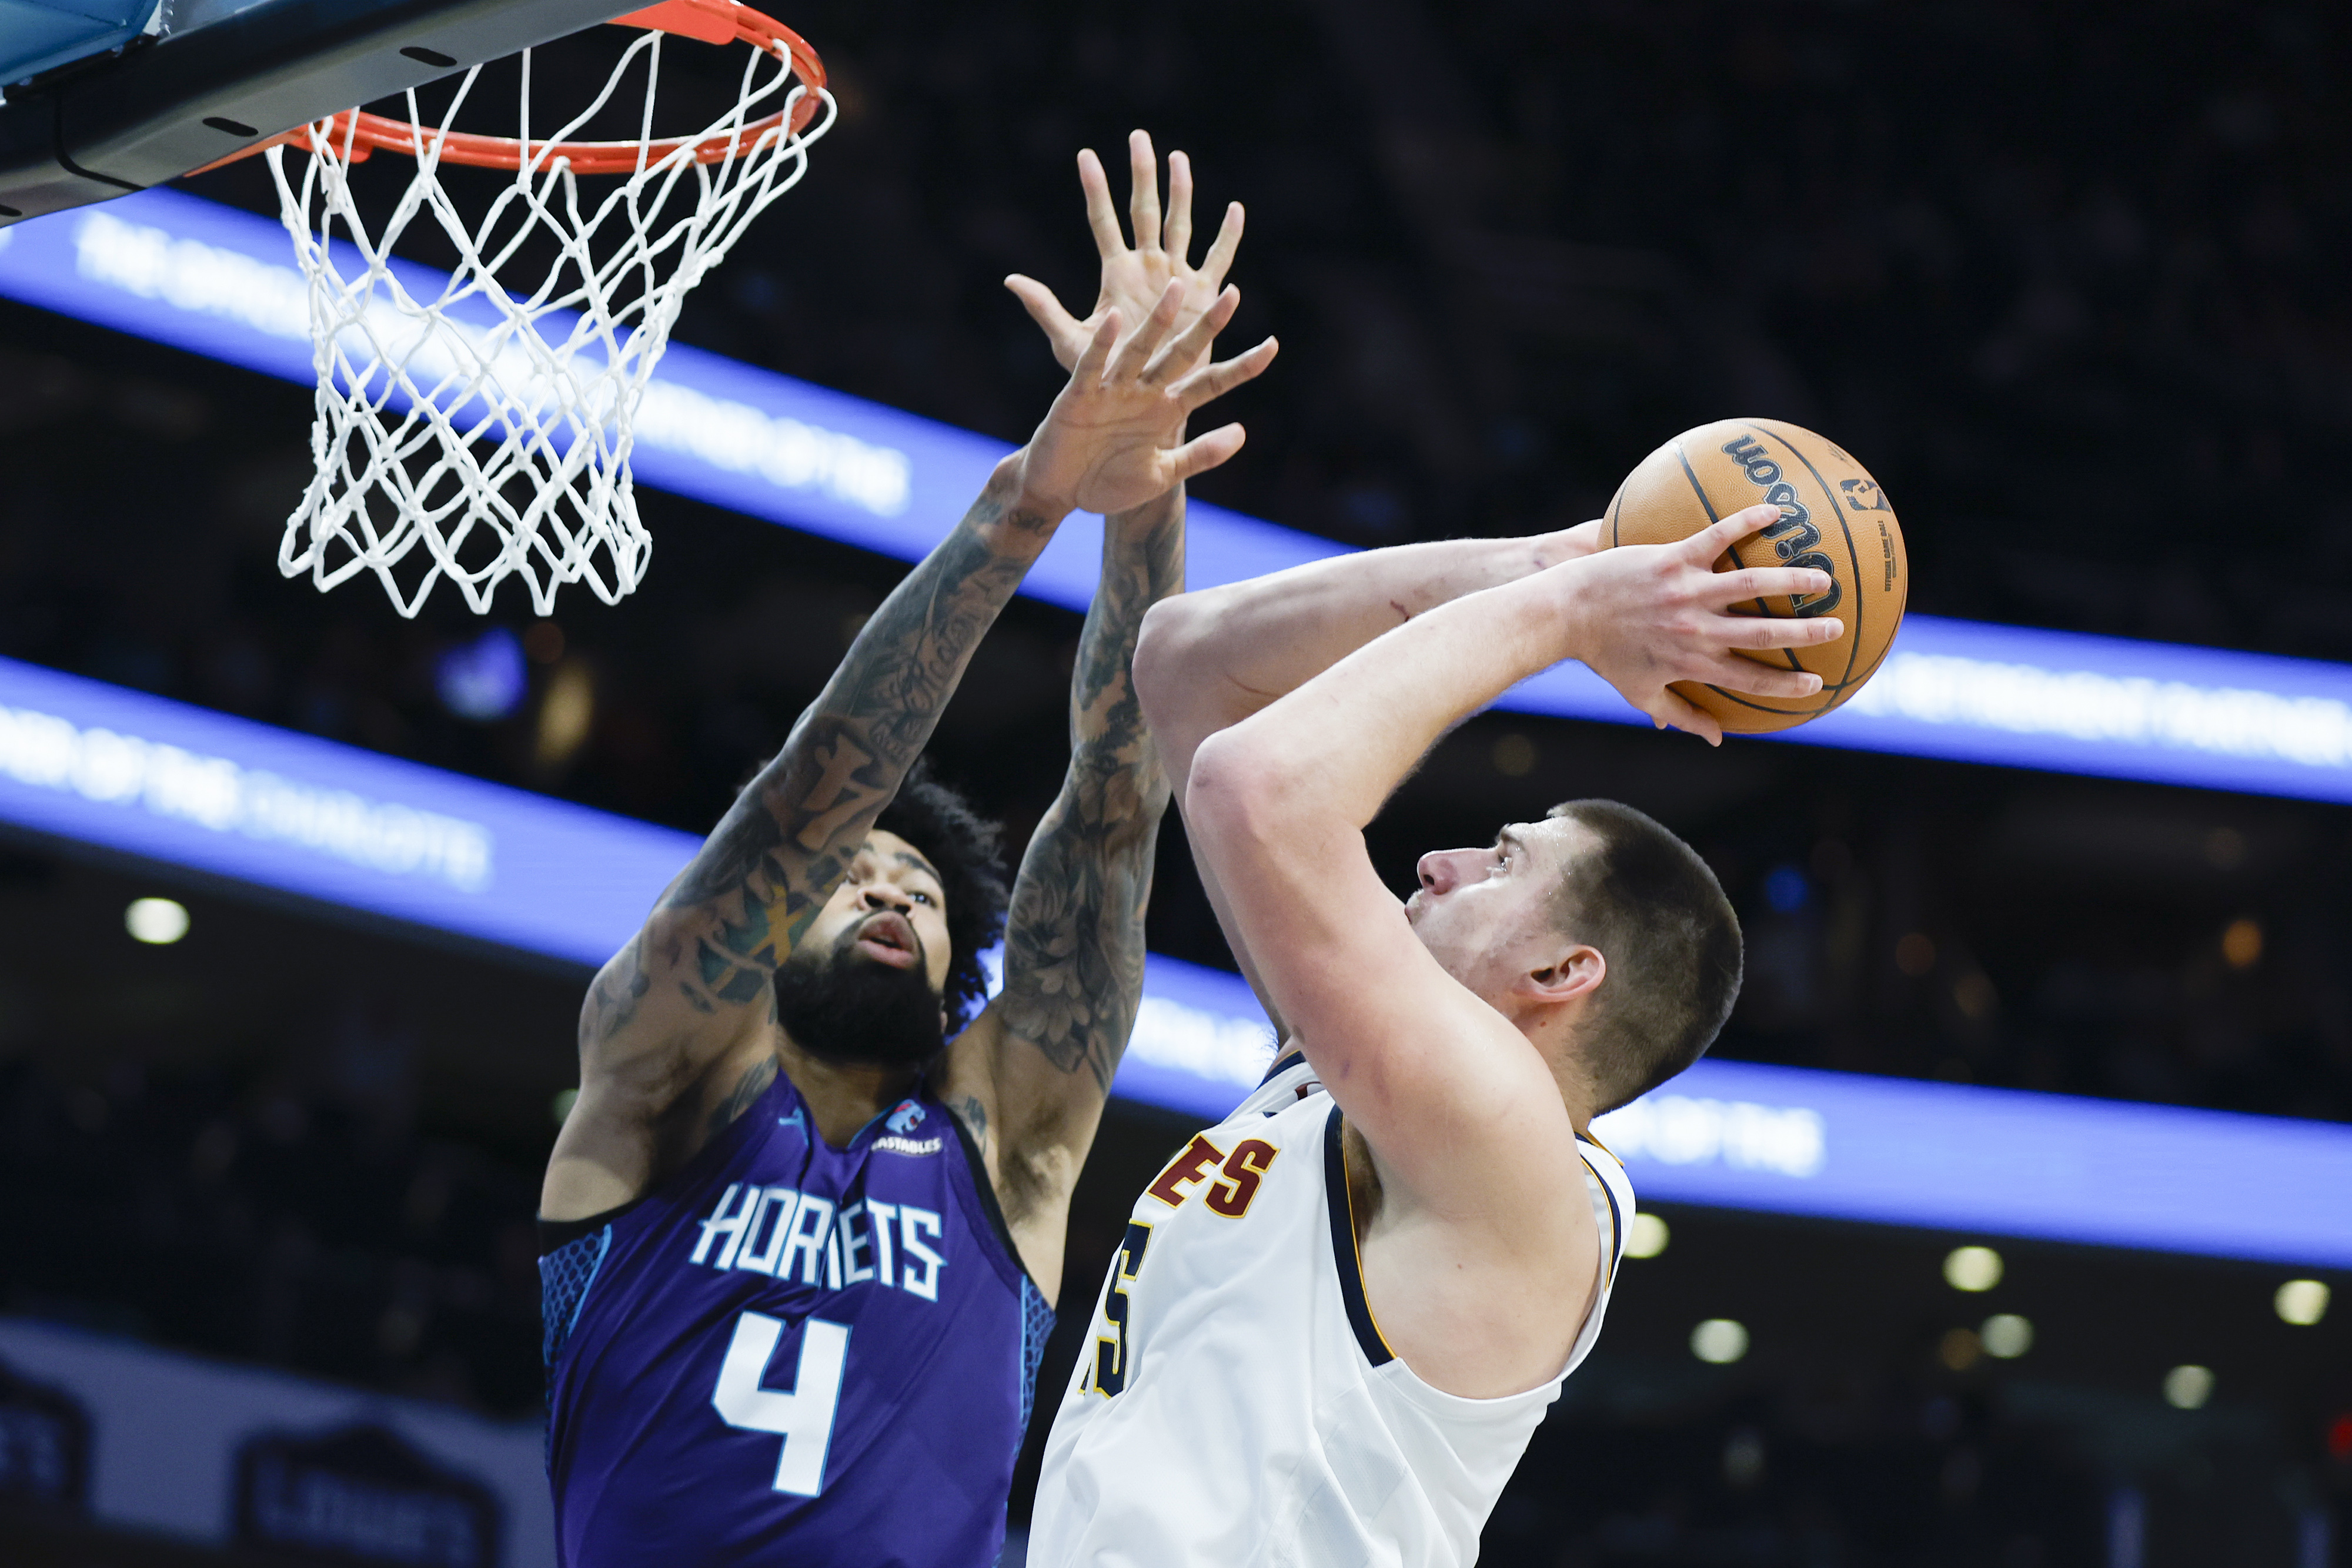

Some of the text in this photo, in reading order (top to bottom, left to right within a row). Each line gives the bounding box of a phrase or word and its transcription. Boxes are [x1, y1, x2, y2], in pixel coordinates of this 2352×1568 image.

[1722, 434, 1841, 617] Wilson
[1077, 1218, 1154, 1399] 5
[710, 1311, 853, 1498] 4
